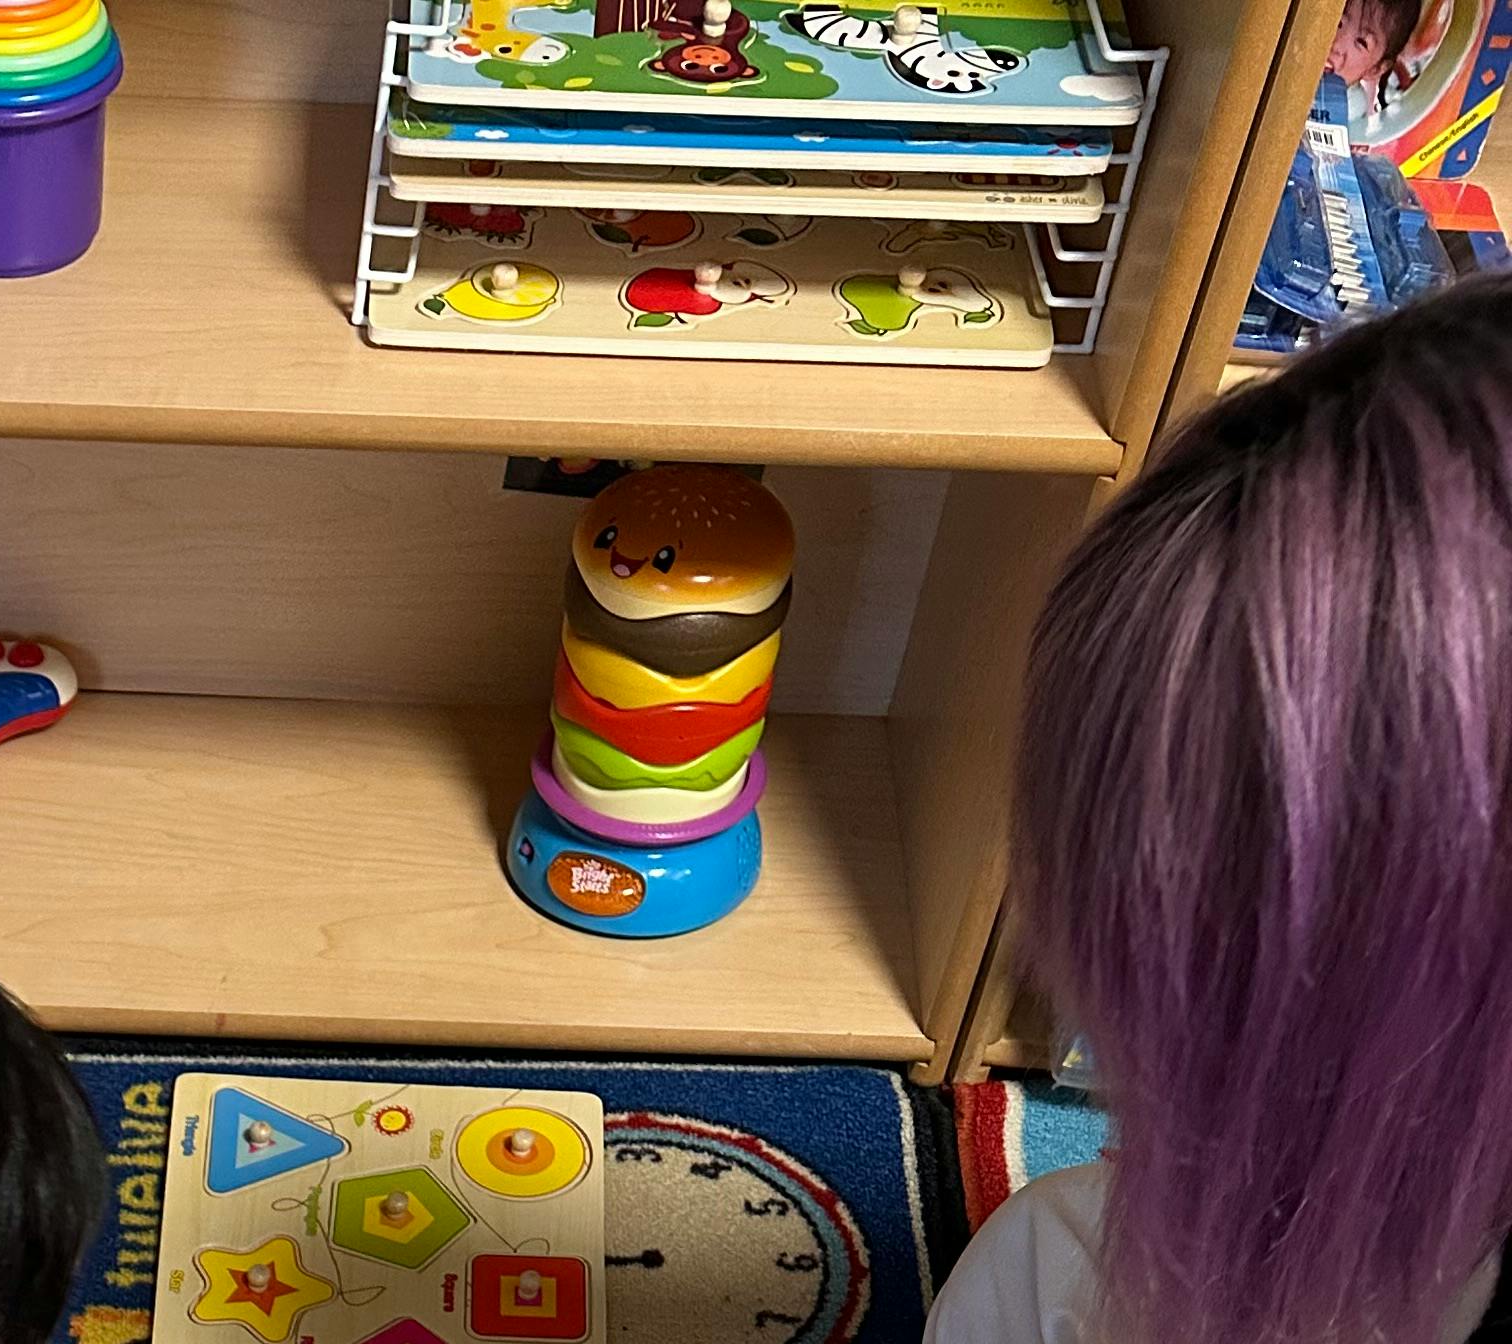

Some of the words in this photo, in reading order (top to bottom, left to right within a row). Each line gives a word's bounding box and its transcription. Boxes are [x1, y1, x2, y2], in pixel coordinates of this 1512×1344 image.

[571, 866, 615, 881] Bright
[570, 880, 610, 894] Starts
[180, 1114, 201, 1157] Triangle
[615, 1149, 662, 1163] 3
[690, 1160, 733, 1180] 4
[744, 1197, 790, 1217] 5
[776, 1251, 820, 1273] 6
[168, 1268, 185, 1295] Star
[440, 1272, 460, 1313] Square
[755, 1309, 803, 1328] 7
